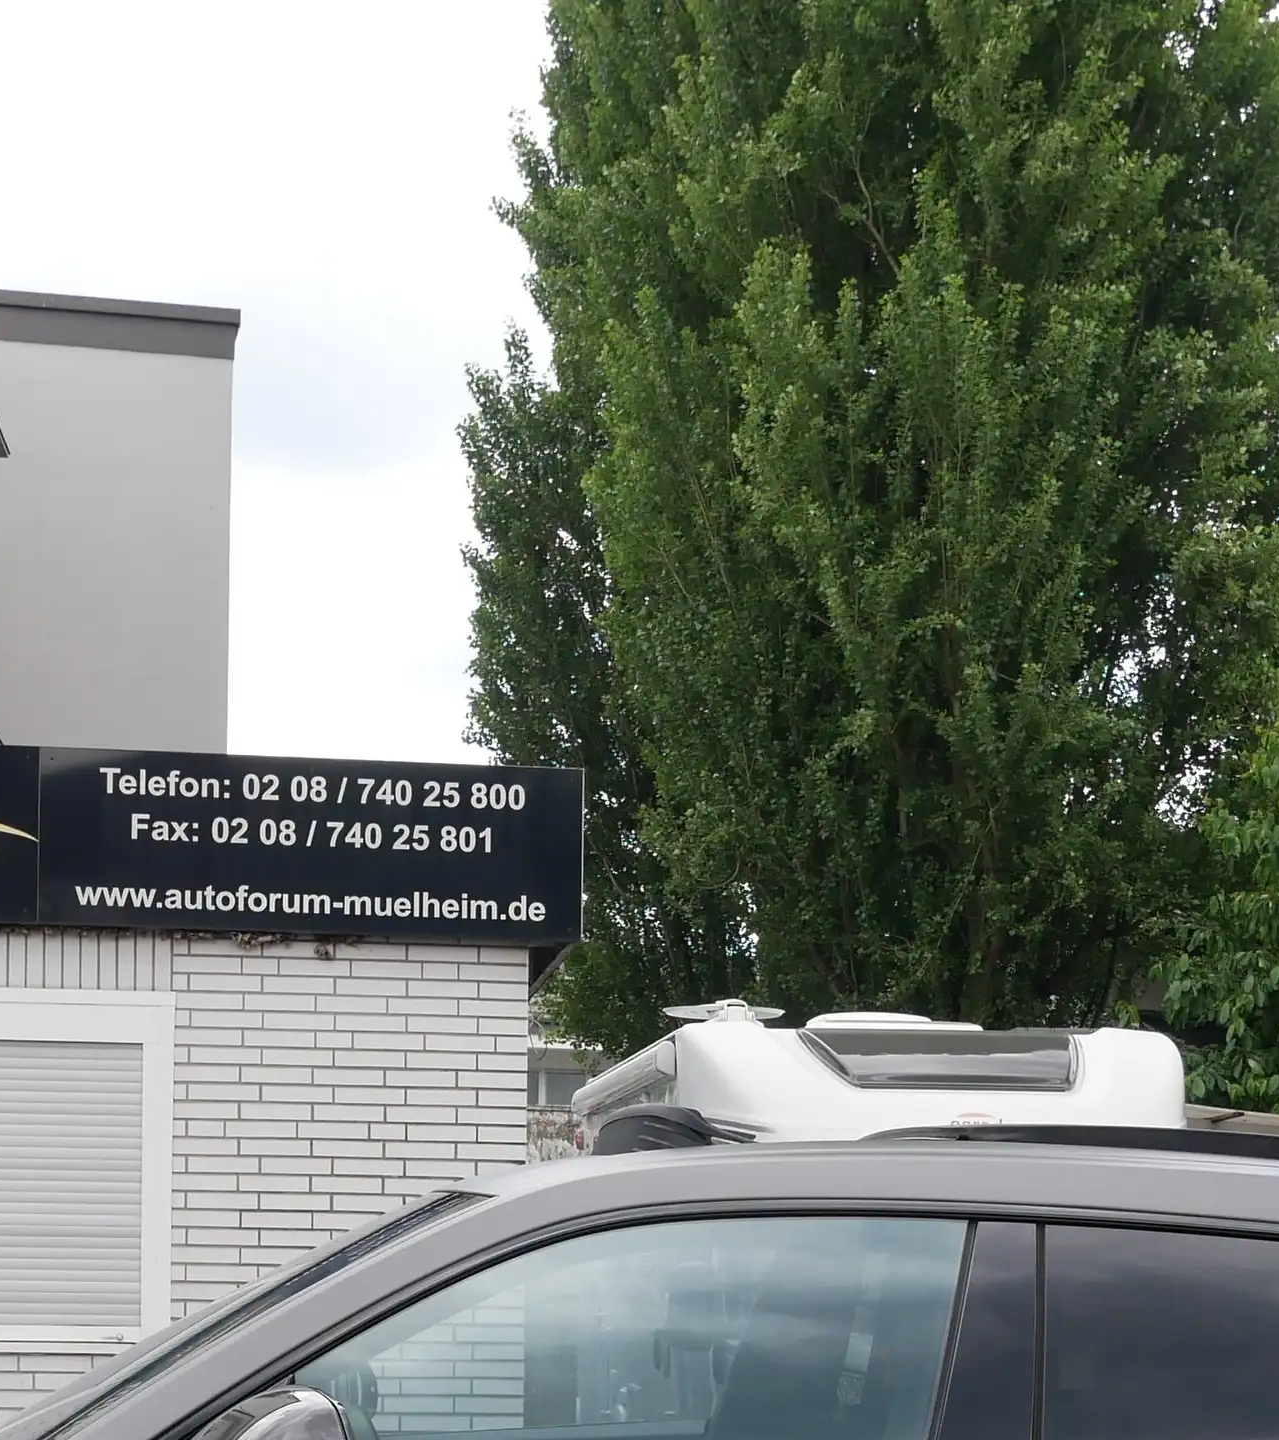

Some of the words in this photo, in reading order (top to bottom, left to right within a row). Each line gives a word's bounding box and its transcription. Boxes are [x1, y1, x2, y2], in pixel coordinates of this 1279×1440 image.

[99, 766, 231, 799] Telefon:
[242, 773, 280, 801] 02
[290, 775, 328, 803] 08
[336, 776, 349, 804] /
[357, 777, 413, 806] 740
[422, 780, 461, 808] 25
[470, 782, 526, 811] 800
[130, 813, 199, 844] Fax:
[211, 816, 249, 844] 02
[259, 818, 297, 846] 08
[305, 819, 318, 847] /
[326, 821, 383, 850] 740
[392, 823, 430, 851] 25
[439, 825, 492, 853] 801
[74, 884, 546, 923] www.autoforum-muelheim.de
